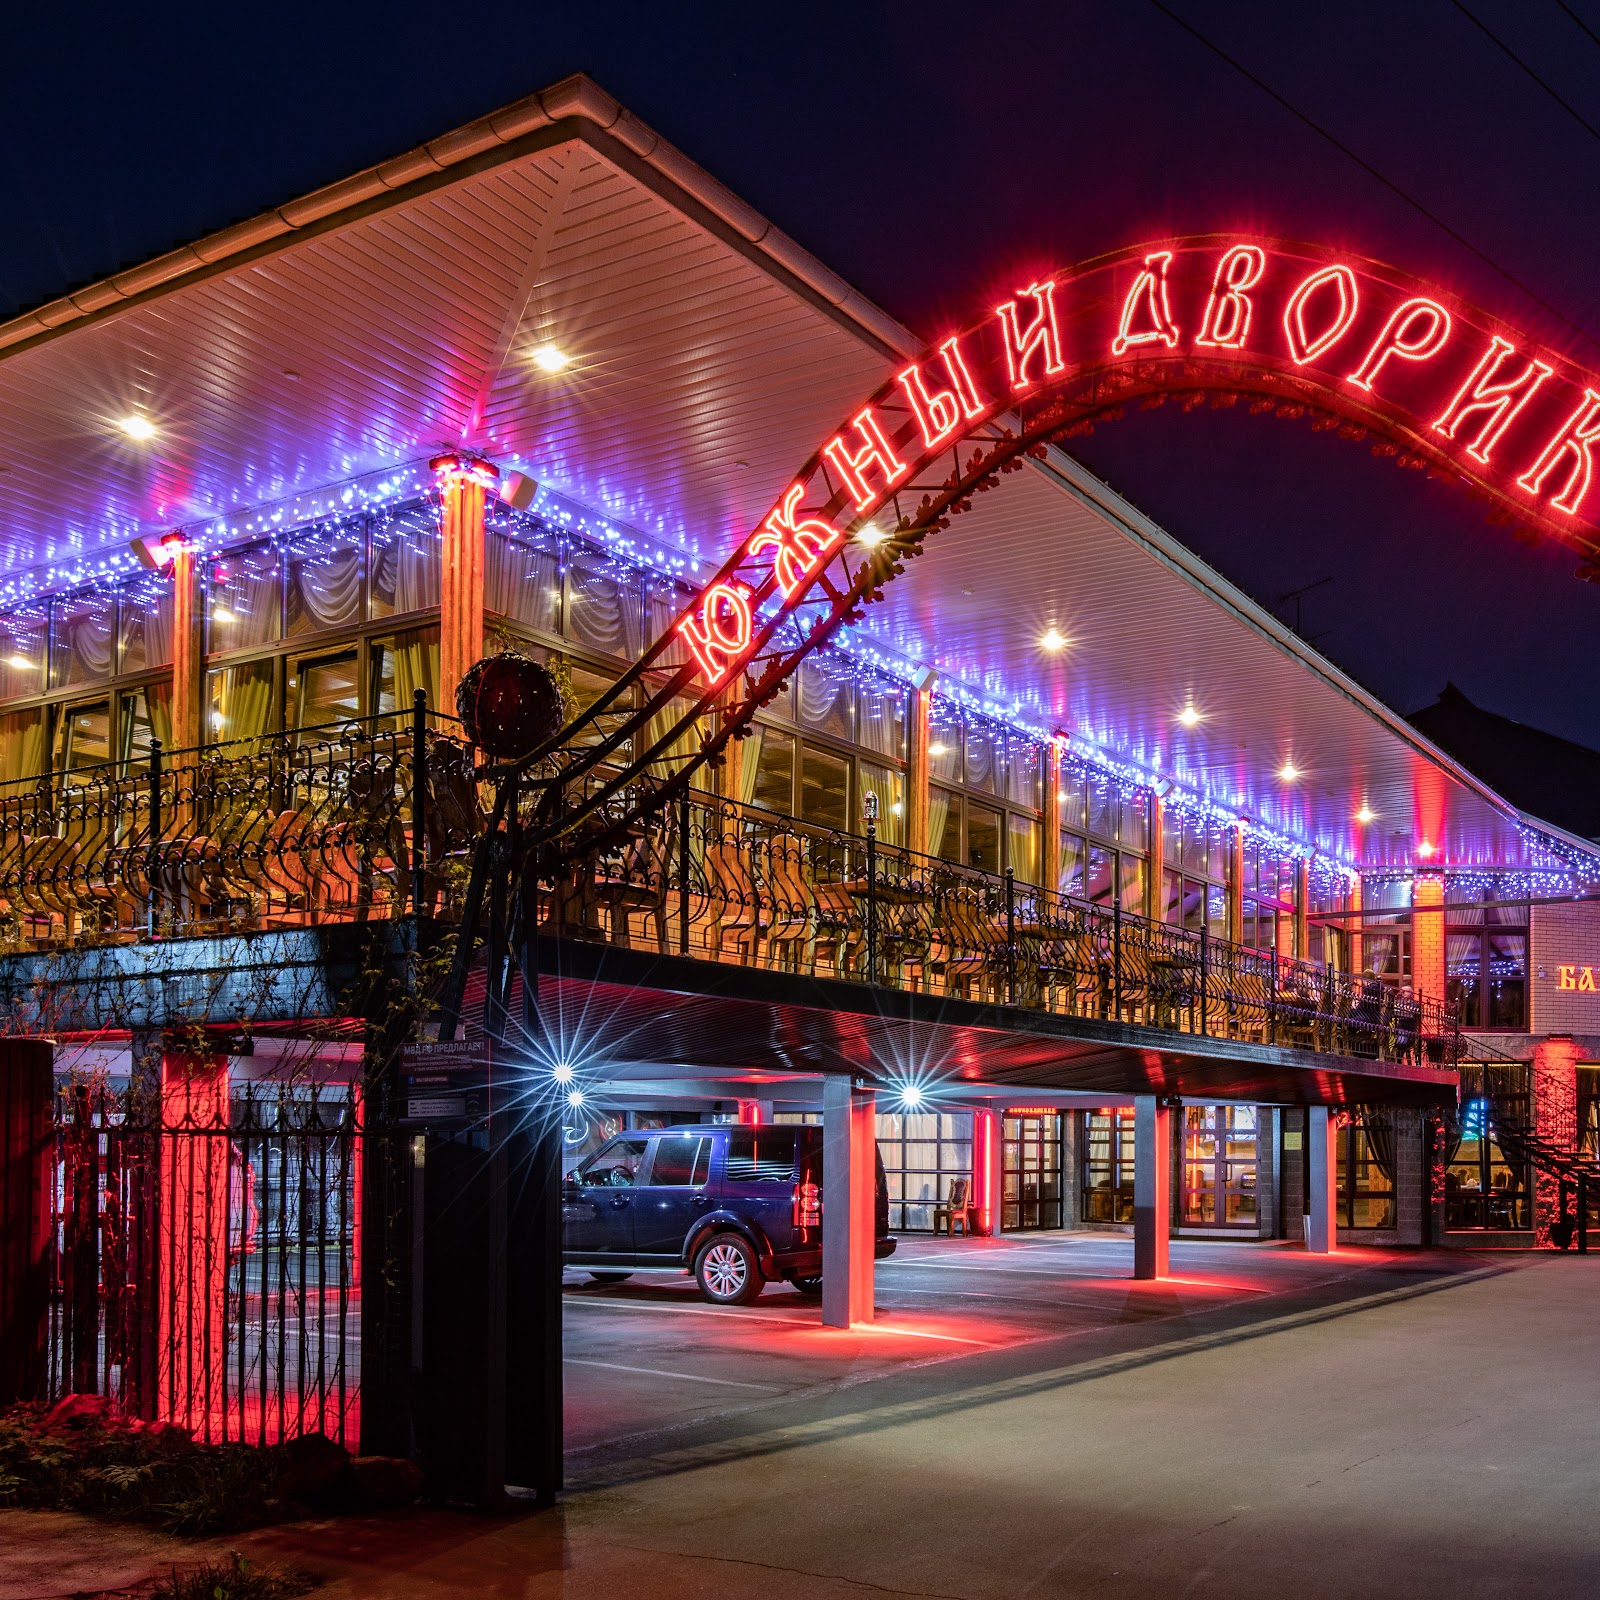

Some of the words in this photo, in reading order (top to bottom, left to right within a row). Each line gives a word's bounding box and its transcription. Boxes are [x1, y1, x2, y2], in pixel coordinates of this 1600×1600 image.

[677, 281, 1065, 685] ЮЖНЫЙ
[1111, 244, 1600, 516] ДВОРИК
[404, 1045, 421, 1056] МВД
[422, 1045, 434, 1054] РФ
[435, 1042, 485, 1054] ПРЕДЛАГАЕТ!
